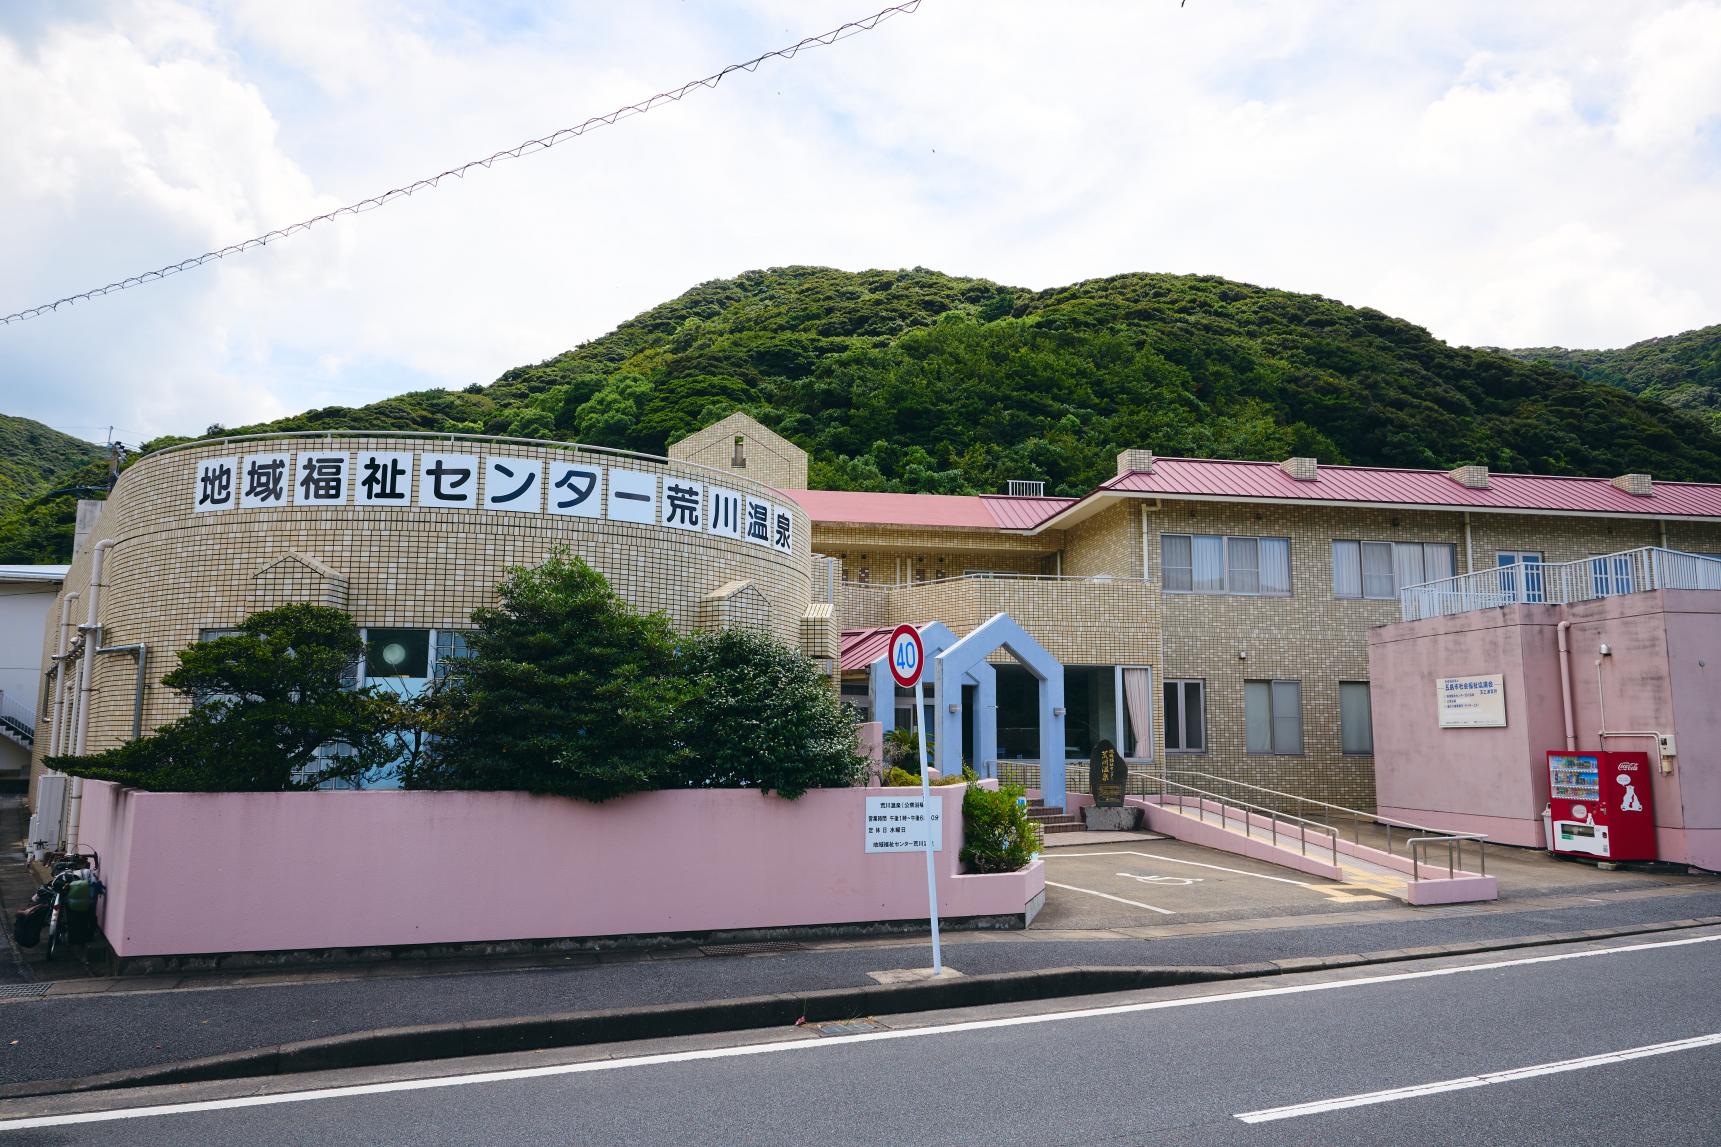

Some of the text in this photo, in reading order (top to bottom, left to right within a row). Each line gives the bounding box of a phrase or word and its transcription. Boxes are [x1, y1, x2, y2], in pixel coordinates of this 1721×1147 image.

[198, 457, 792, 550] 地域福祉センター荒川温泉
[896, 641, 916, 670] 40
